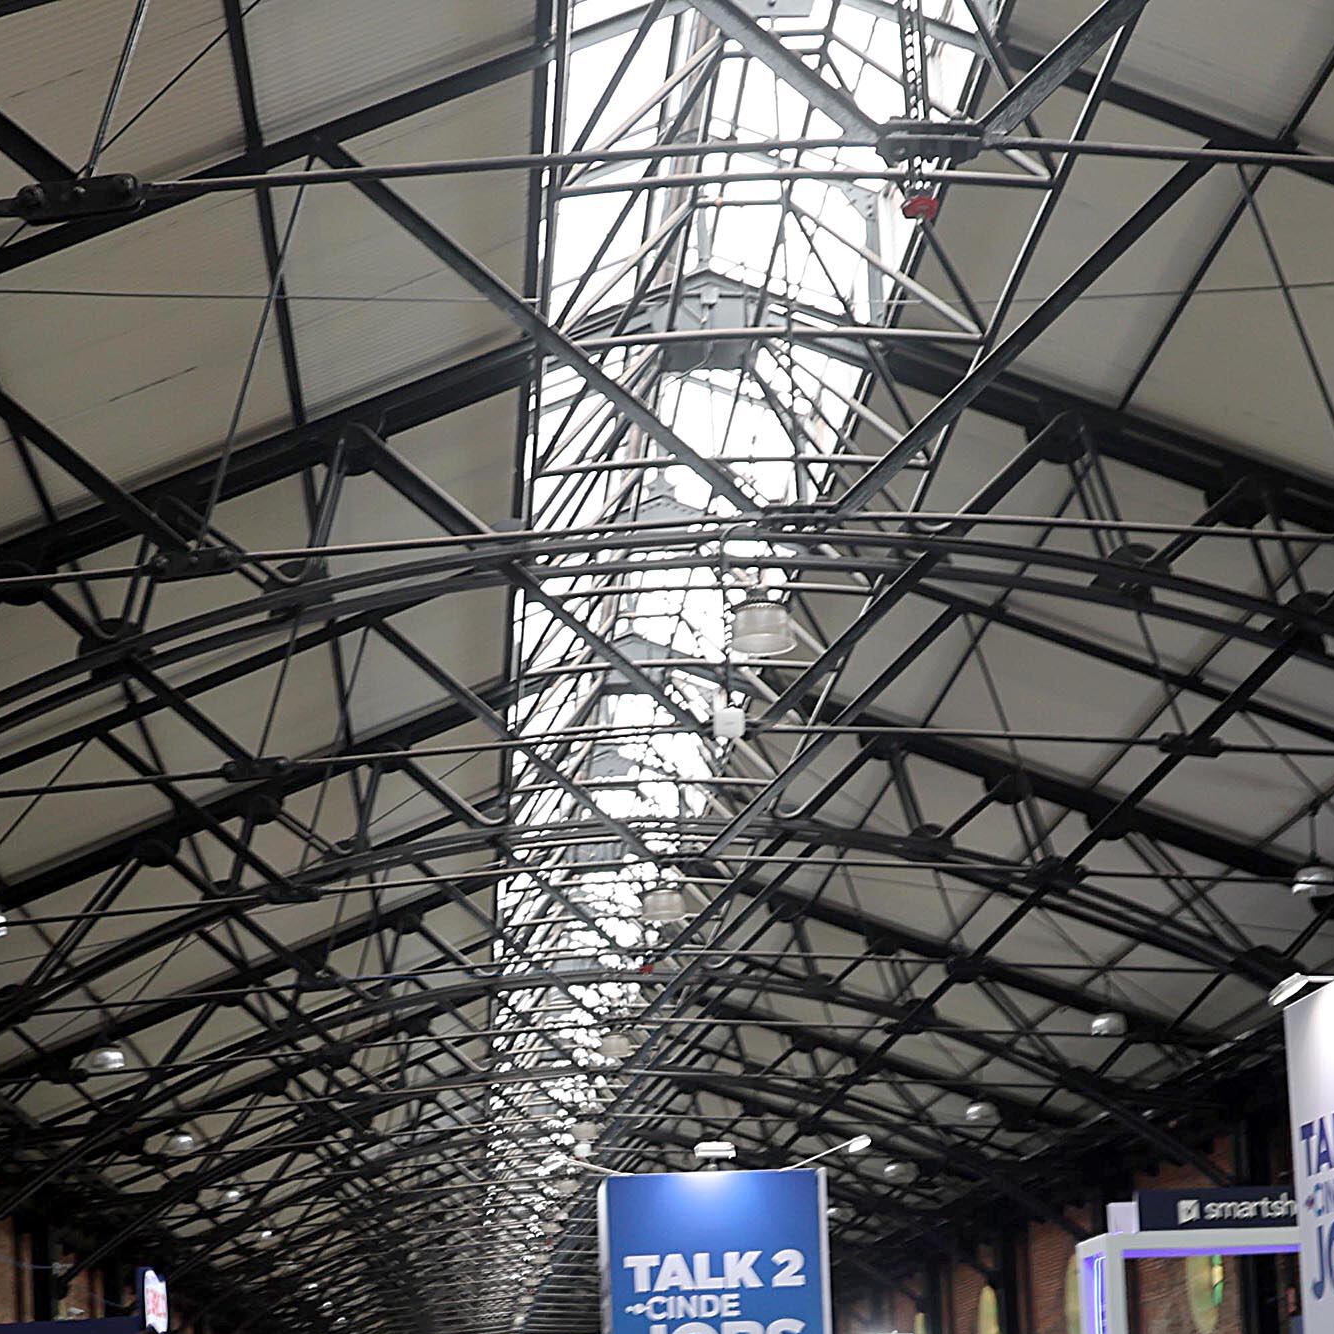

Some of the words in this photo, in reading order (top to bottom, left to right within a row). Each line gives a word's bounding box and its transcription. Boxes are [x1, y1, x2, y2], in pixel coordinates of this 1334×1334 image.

[623, 1250, 765, 1293] TALK
[771, 1249, 806, 1287] 2
[646, 1293, 741, 1321] CINDE
